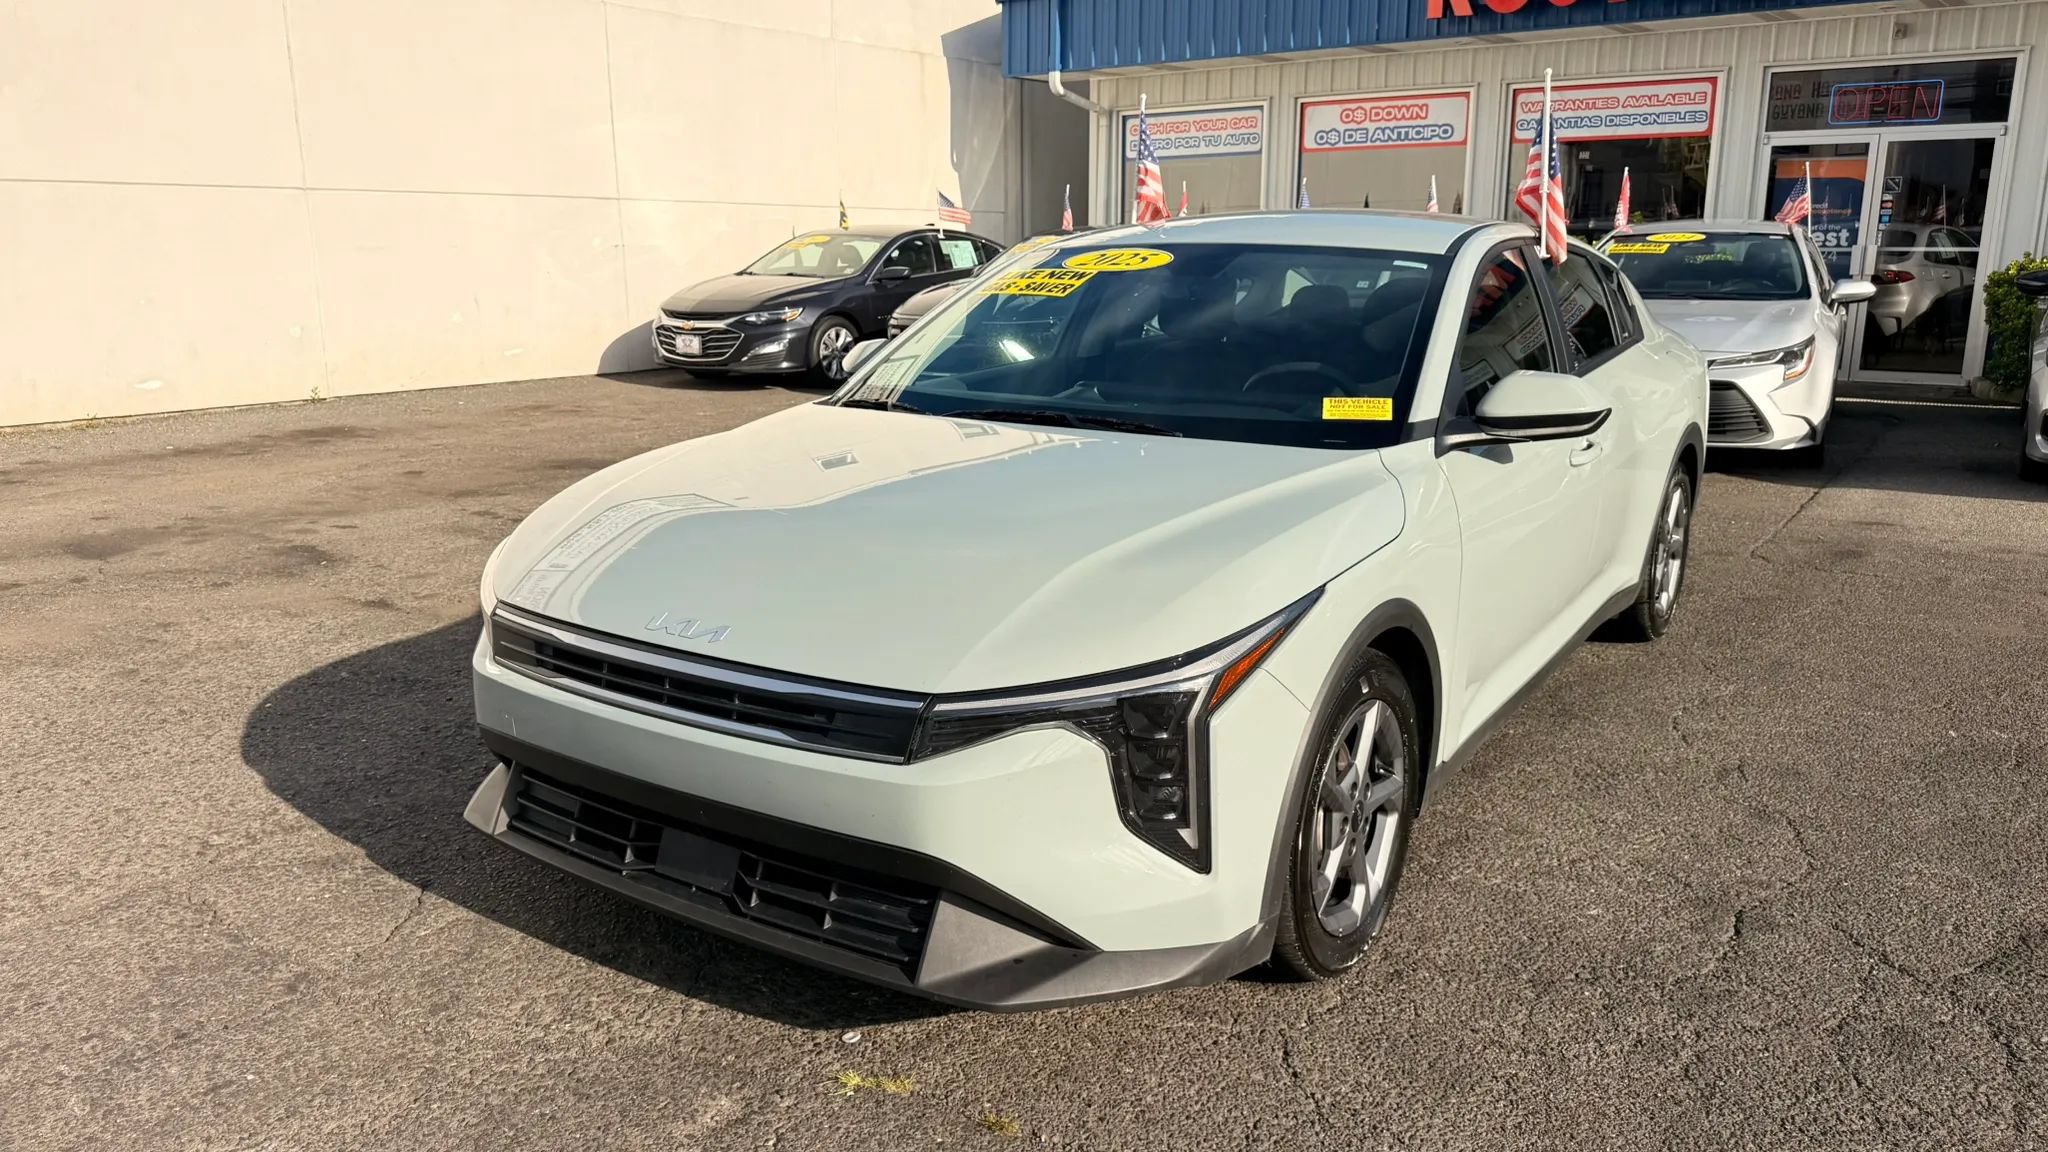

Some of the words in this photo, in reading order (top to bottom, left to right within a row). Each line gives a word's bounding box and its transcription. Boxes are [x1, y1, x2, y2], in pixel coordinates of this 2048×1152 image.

[1622, 92, 1708, 109] AVAILABLE
[1834, 85, 1941, 121] OPEN
[1369, 104, 1428, 121] DOWN
[1605, 110, 1708, 127] DISPONIBLES
[1130, 122, 1164, 136] CSH
[1165, 121, 1192, 134] FOR
[1192, 119, 1228, 132] YOUR
[1230, 117, 1258, 129] CAR
[1343, 127, 1369, 144] DE
[1370, 124, 1453, 142] ANTICIPO
[1130, 138, 1172, 151] DERO
[1174, 137, 1200, 149] POR
[1202, 135, 1222, 147] TU
[1223, 133, 1260, 146] AUTO
[1812, 229, 1849, 247] est
[1076, 251, 1161, 267] 2025
[1041, 269, 1090, 281] NEW
